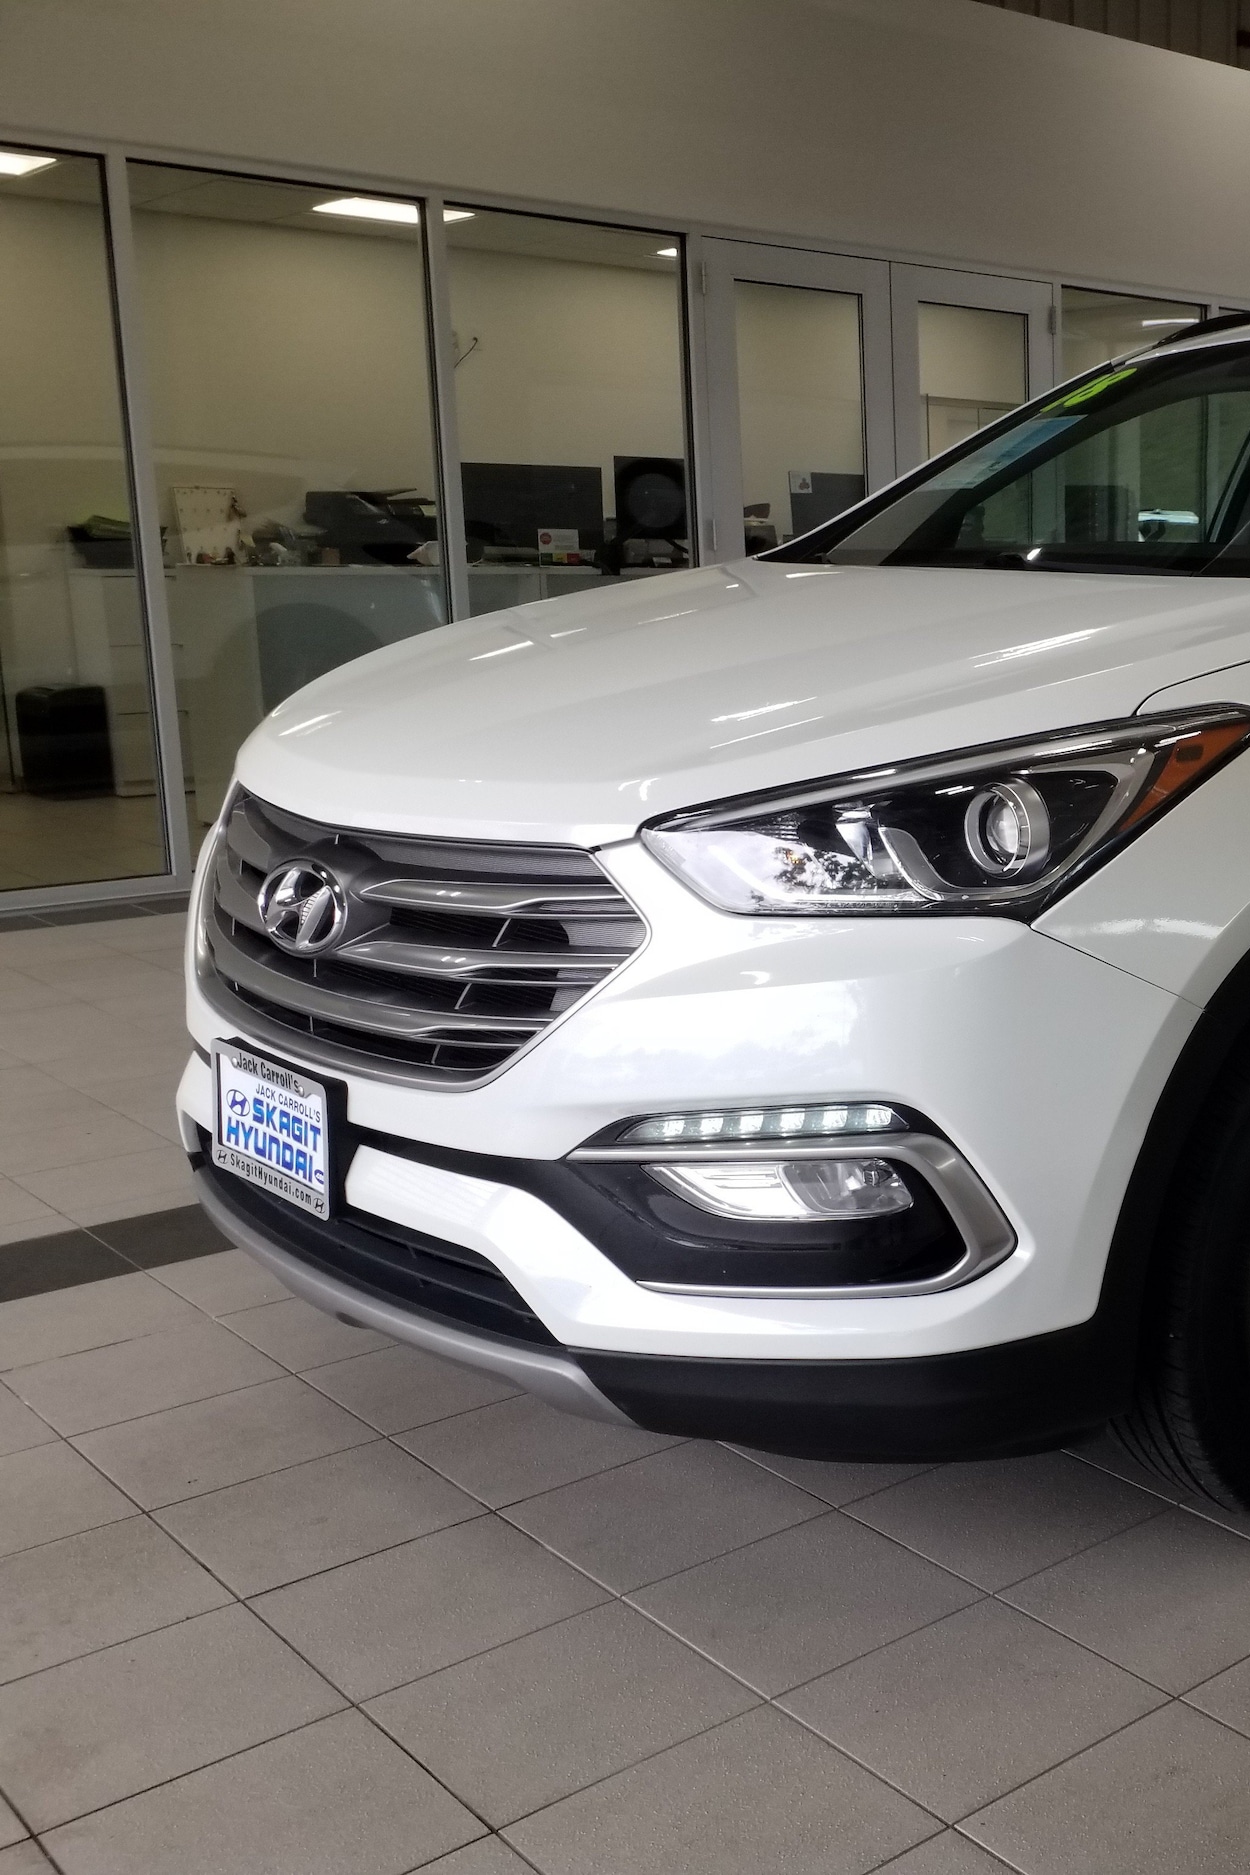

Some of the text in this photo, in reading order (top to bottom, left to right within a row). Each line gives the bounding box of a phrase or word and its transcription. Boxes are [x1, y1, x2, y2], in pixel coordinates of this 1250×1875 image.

[237, 1052, 299, 1092] Jack Carroll's
[252, 1097, 321, 1152] SKAGIT
[255, 1083, 321, 1123] JACK CARROLL'S
[226, 1116, 313, 1183] HYUNDAI
[230, 1152, 312, 1206] SkagitHyundai.com
